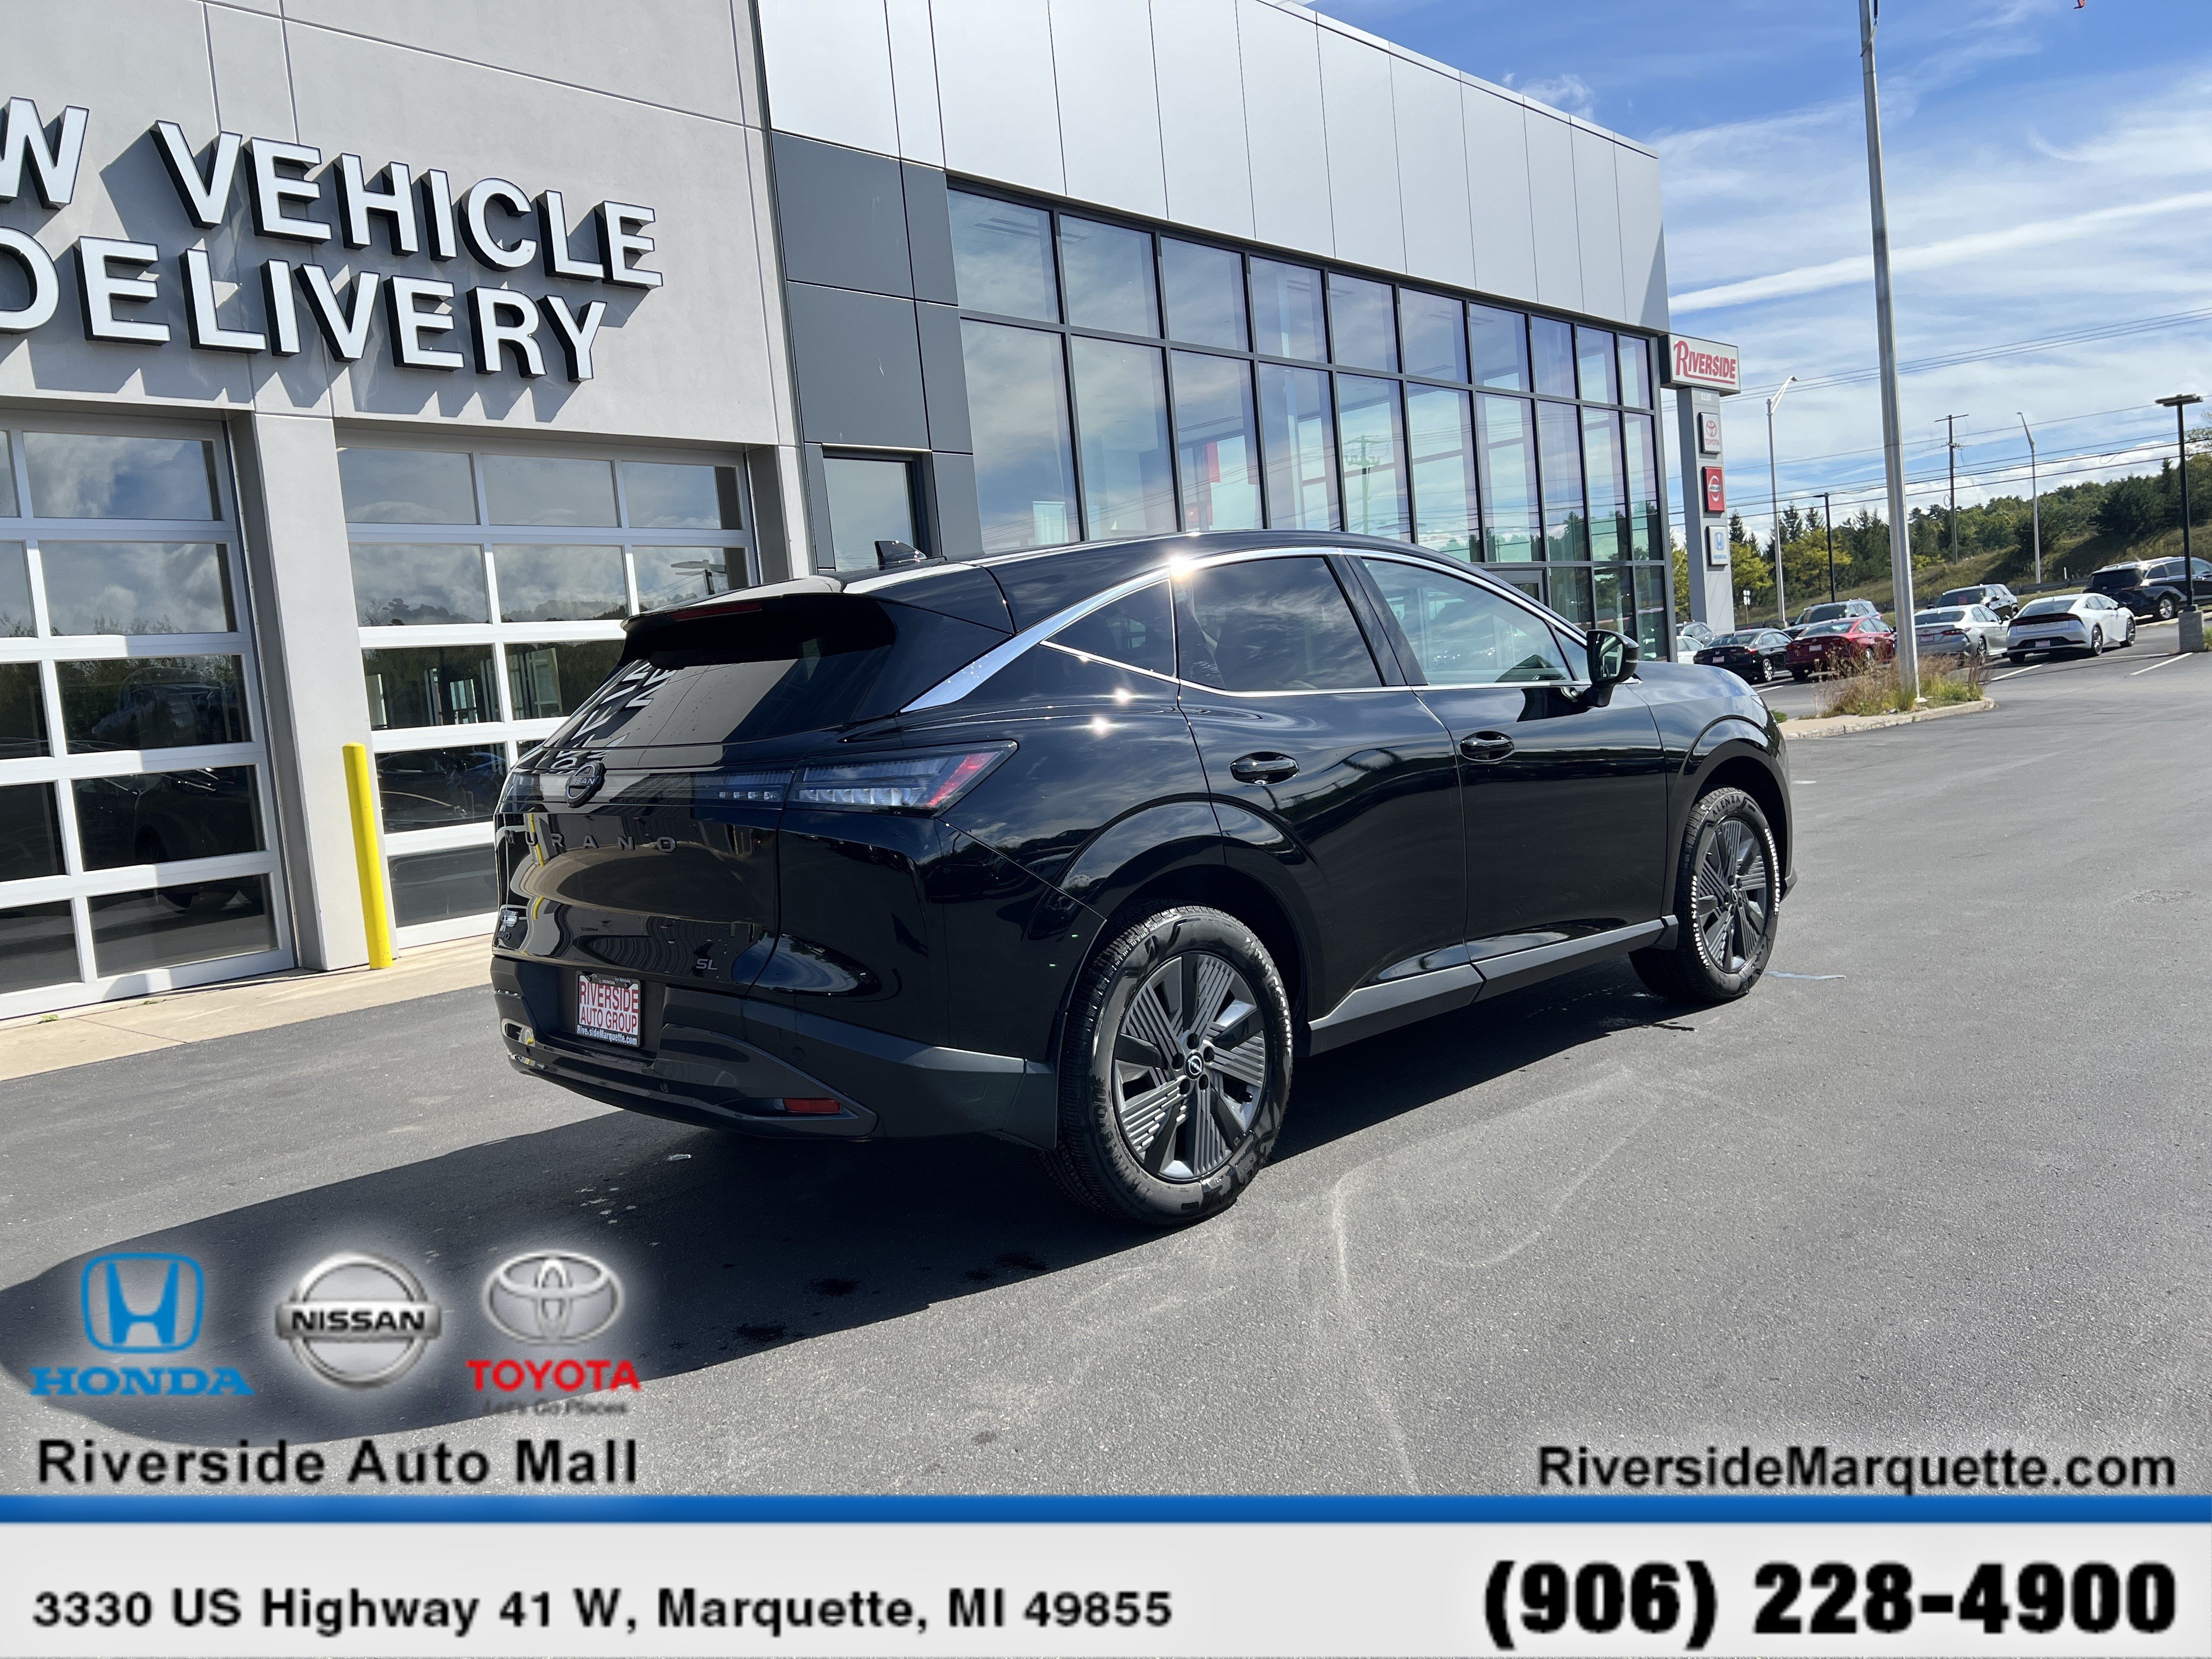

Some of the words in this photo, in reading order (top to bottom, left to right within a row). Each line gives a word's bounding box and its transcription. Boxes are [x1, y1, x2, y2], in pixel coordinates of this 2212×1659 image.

[148, 120, 663, 290] VEHICLE
[0, 227, 607, 383] DELIVERY
[1673, 340, 1736, 384] RIVERSIDE
[505, 829, 677, 854] MURANO
[697, 960, 718, 970] SL
[579, 981, 639, 1014] RIVERSIDE
[580, 1006, 603, 1028] AUTO
[605, 1010, 637, 1034] GROUP
